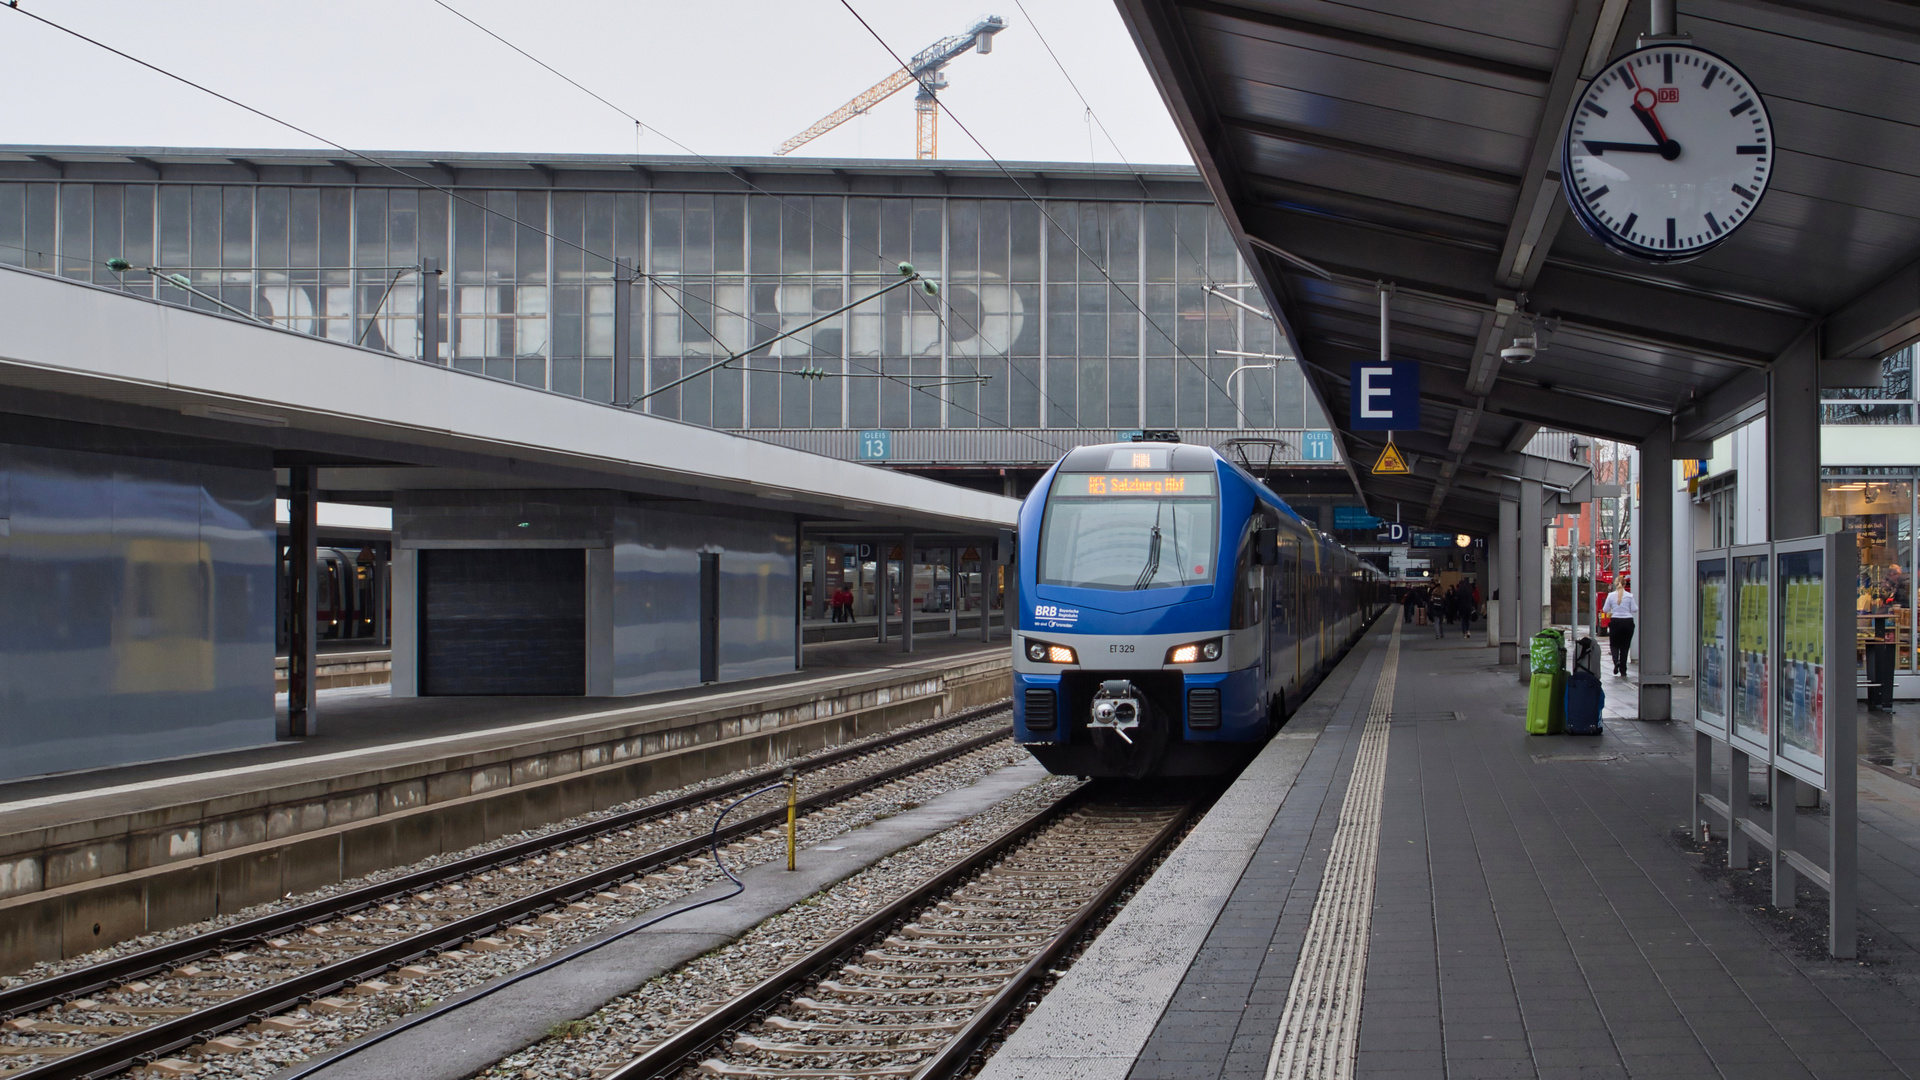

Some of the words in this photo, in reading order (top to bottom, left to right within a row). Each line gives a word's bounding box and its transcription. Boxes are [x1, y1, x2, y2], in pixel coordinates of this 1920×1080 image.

[1661, 90, 1677, 101] DB
[1361, 367, 1393, 418] E
[865, 439, 884, 457] 13
[1310, 440, 1324, 458] 11
[1110, 478, 1162, 494] Salzburg
[1164, 477, 1185, 492] Hbf
[1391, 524, 1403, 540] D
[860, 543, 871, 558] D
[1474, 538, 1484, 548] 11
[1035, 605, 1057, 616] BRB
[1109, 644, 1118, 653] ET
[1119, 644, 1135, 653] 329
